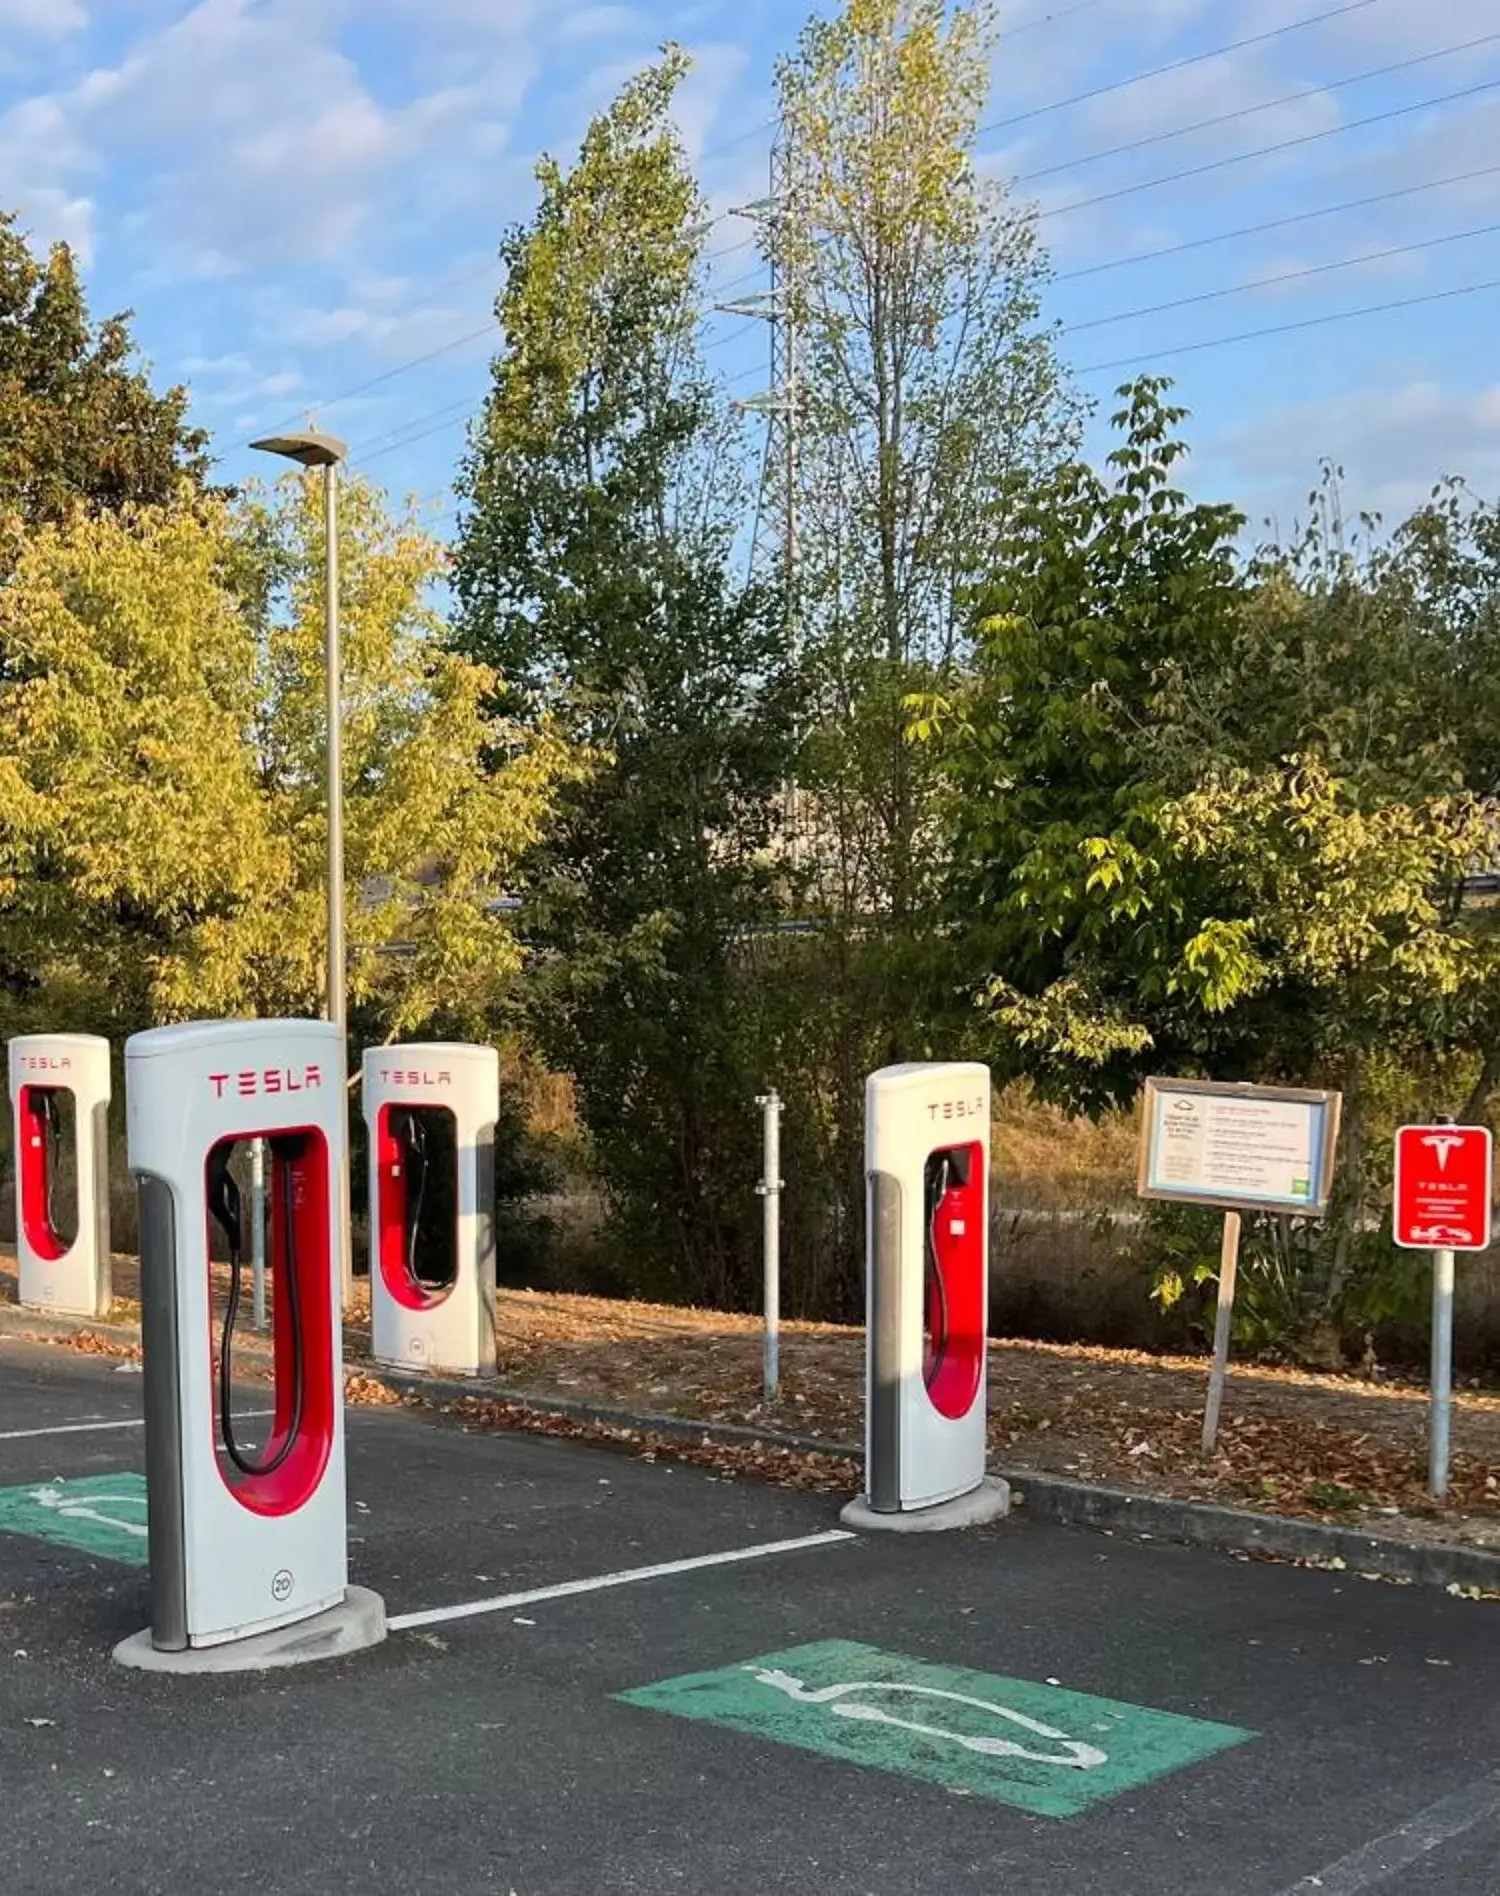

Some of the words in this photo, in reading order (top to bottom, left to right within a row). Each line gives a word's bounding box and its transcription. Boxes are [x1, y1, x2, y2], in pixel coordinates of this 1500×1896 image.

[209, 1066, 320, 1098] TESLA
[380, 1071, 450, 1084] TESLA
[927, 1097, 983, 1120] TESLA
